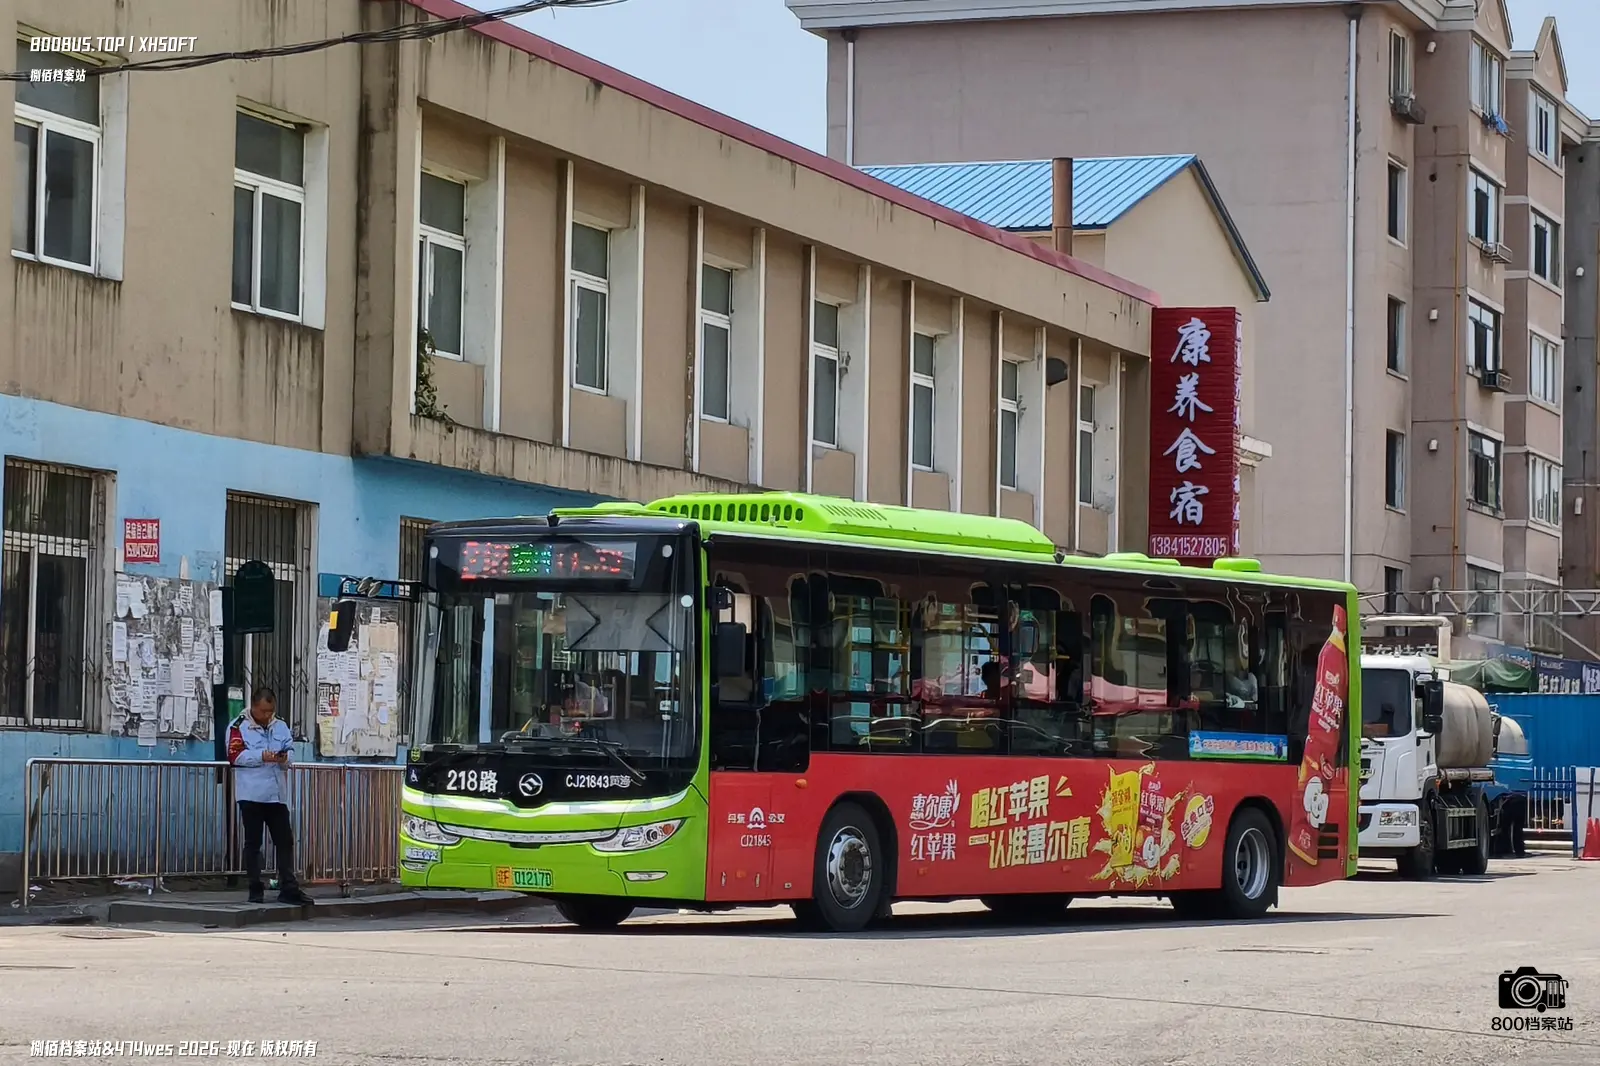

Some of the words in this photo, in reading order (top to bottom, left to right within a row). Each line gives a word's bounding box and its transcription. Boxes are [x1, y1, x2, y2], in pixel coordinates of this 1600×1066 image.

[1163, 317, 1216, 526] 康养食宿
[1152, 536, 1227, 557] 13841527805
[446, 770, 498, 793] 218路
[565, 774, 609, 788] CJ21843
[909, 793, 954, 826] 惠尔康
[970, 775, 1049, 829] 喝红苹果
[910, 833, 956, 861] 红苹果
